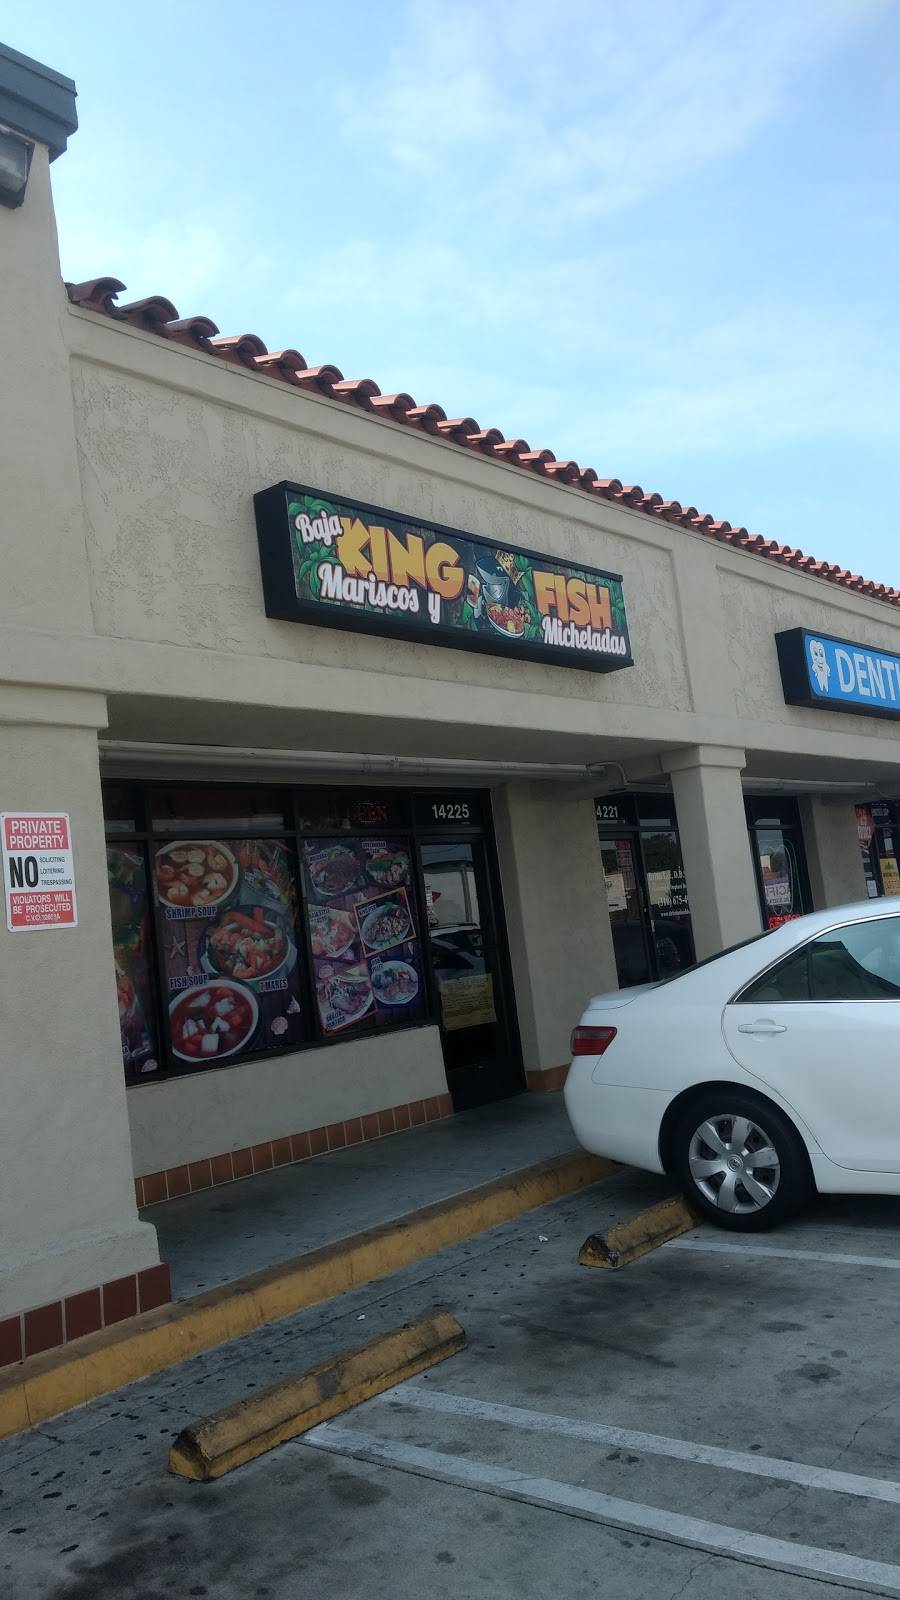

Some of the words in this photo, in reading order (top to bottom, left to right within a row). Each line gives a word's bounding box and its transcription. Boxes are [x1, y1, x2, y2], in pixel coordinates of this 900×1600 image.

[295, 511, 342, 545] Baja
[336, 517, 464, 599] KING
[532, 571, 612, 630] FISH
[318, 563, 419, 613] Mariscos
[428, 594, 441, 623] y
[541, 616, 626, 655] Micheladas
[432, 803, 470, 819] 14225
[11, 820, 61, 834] PRIVATE
[10, 835, 64, 849] PROPERTY
[9, 856, 39, 888] NO
[40, 867, 64, 875] LOITERING
[41, 878, 73, 886] TRESPASSING
[12, 894, 51, 905] VIOLATORS
[54, 893, 71, 903] WILL
[12, 905, 23, 914] BE
[26, 902, 71, 914] PROSECUTED
[166, 908, 196, 919] SHRIMP
[198, 907, 217, 917] SOUP
[170, 977, 188, 989] FISH
[188, 974, 208, 986] SOUP
